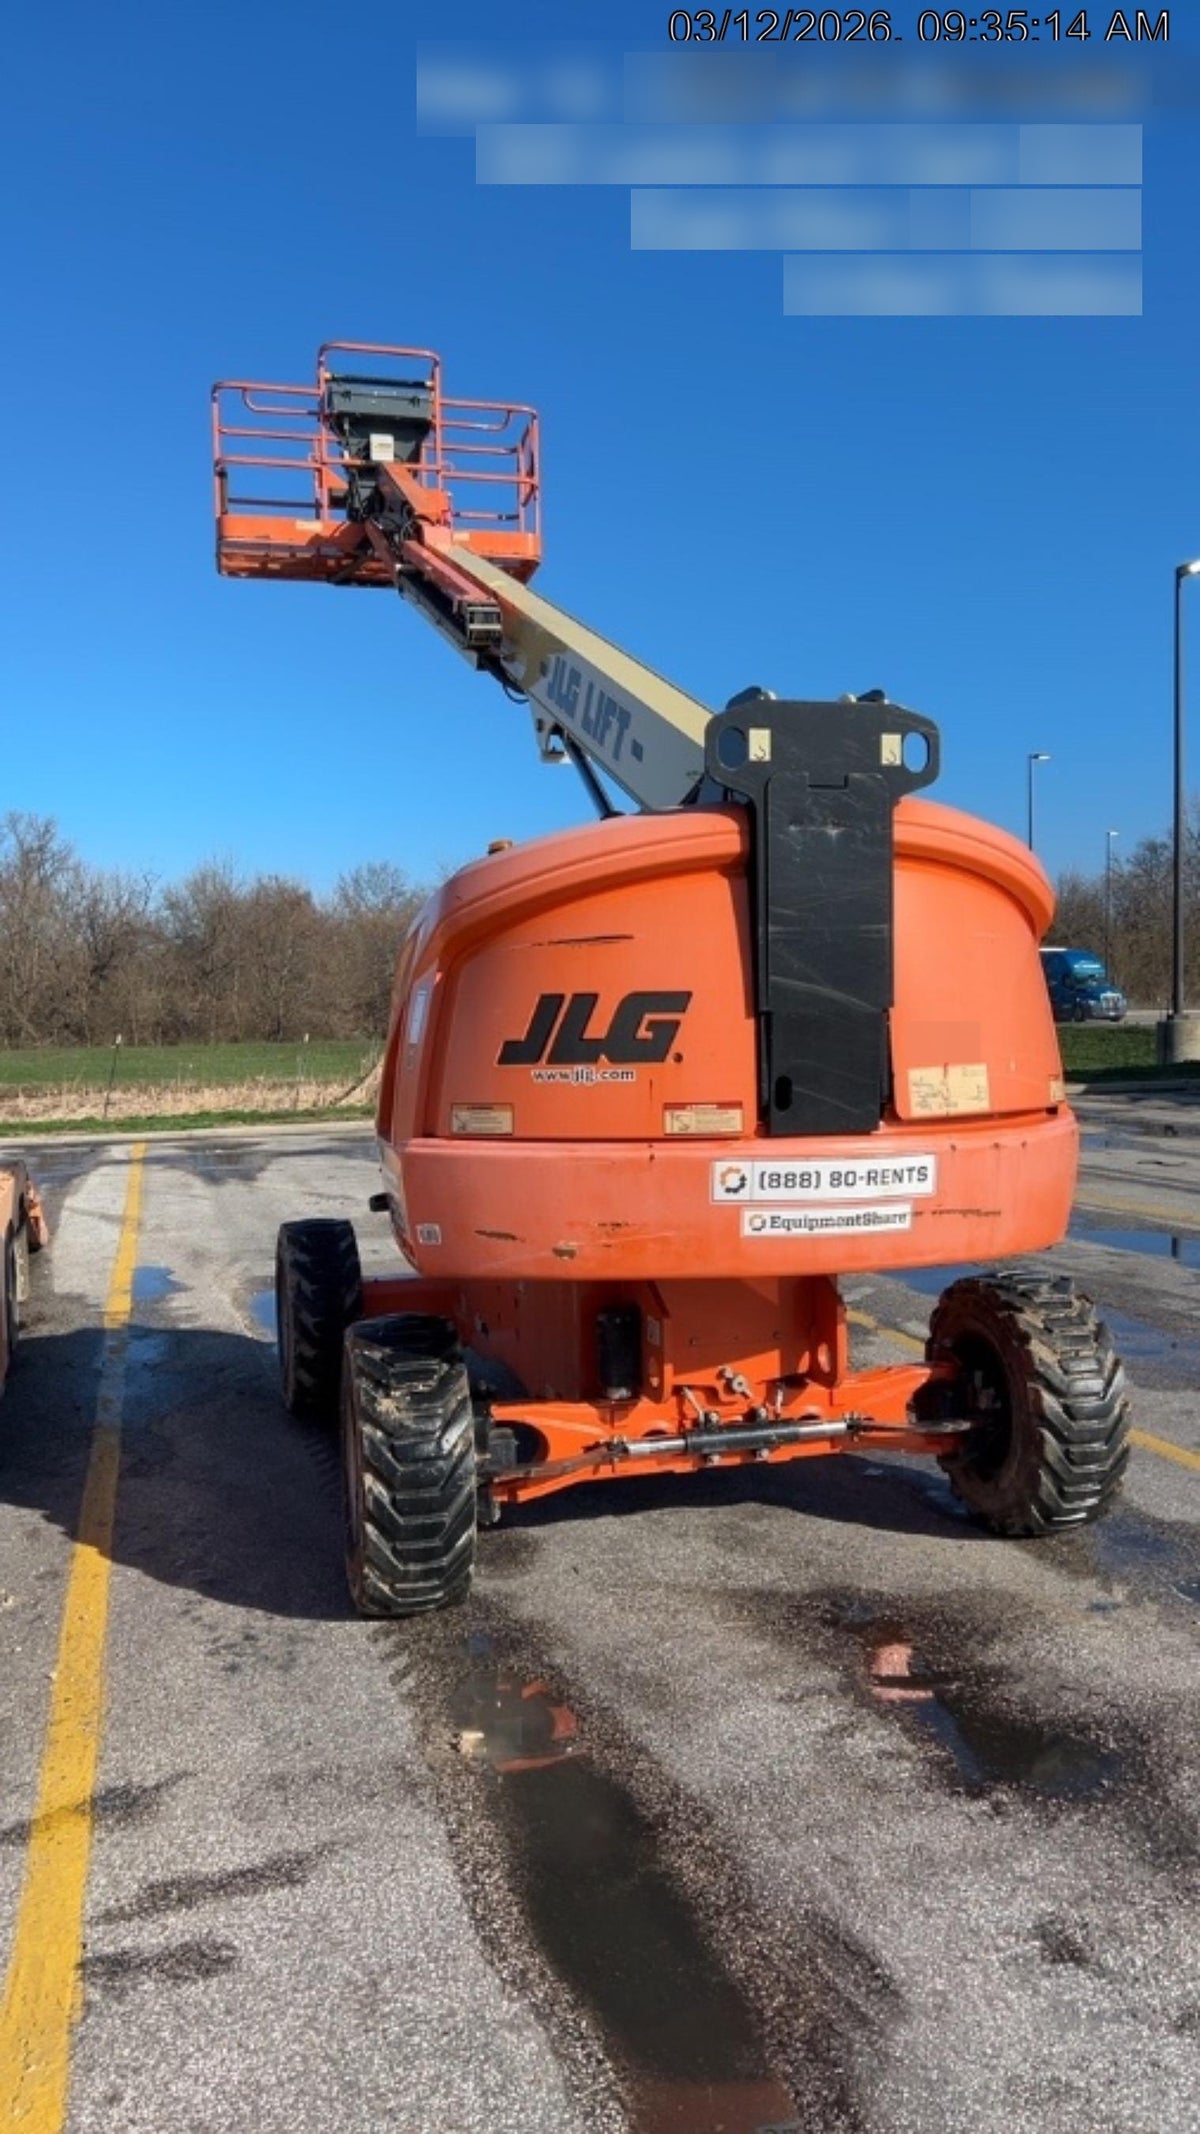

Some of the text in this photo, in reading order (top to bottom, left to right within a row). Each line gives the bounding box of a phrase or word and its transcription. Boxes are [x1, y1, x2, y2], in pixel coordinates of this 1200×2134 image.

[547, 656, 632, 761] JLG LIFT
[531, 1067, 636, 1084] www.jlg.com
[758, 1166, 929, 1190] (888) 80-RENTS
[769, 1211, 908, 1232] EquipmentShare
